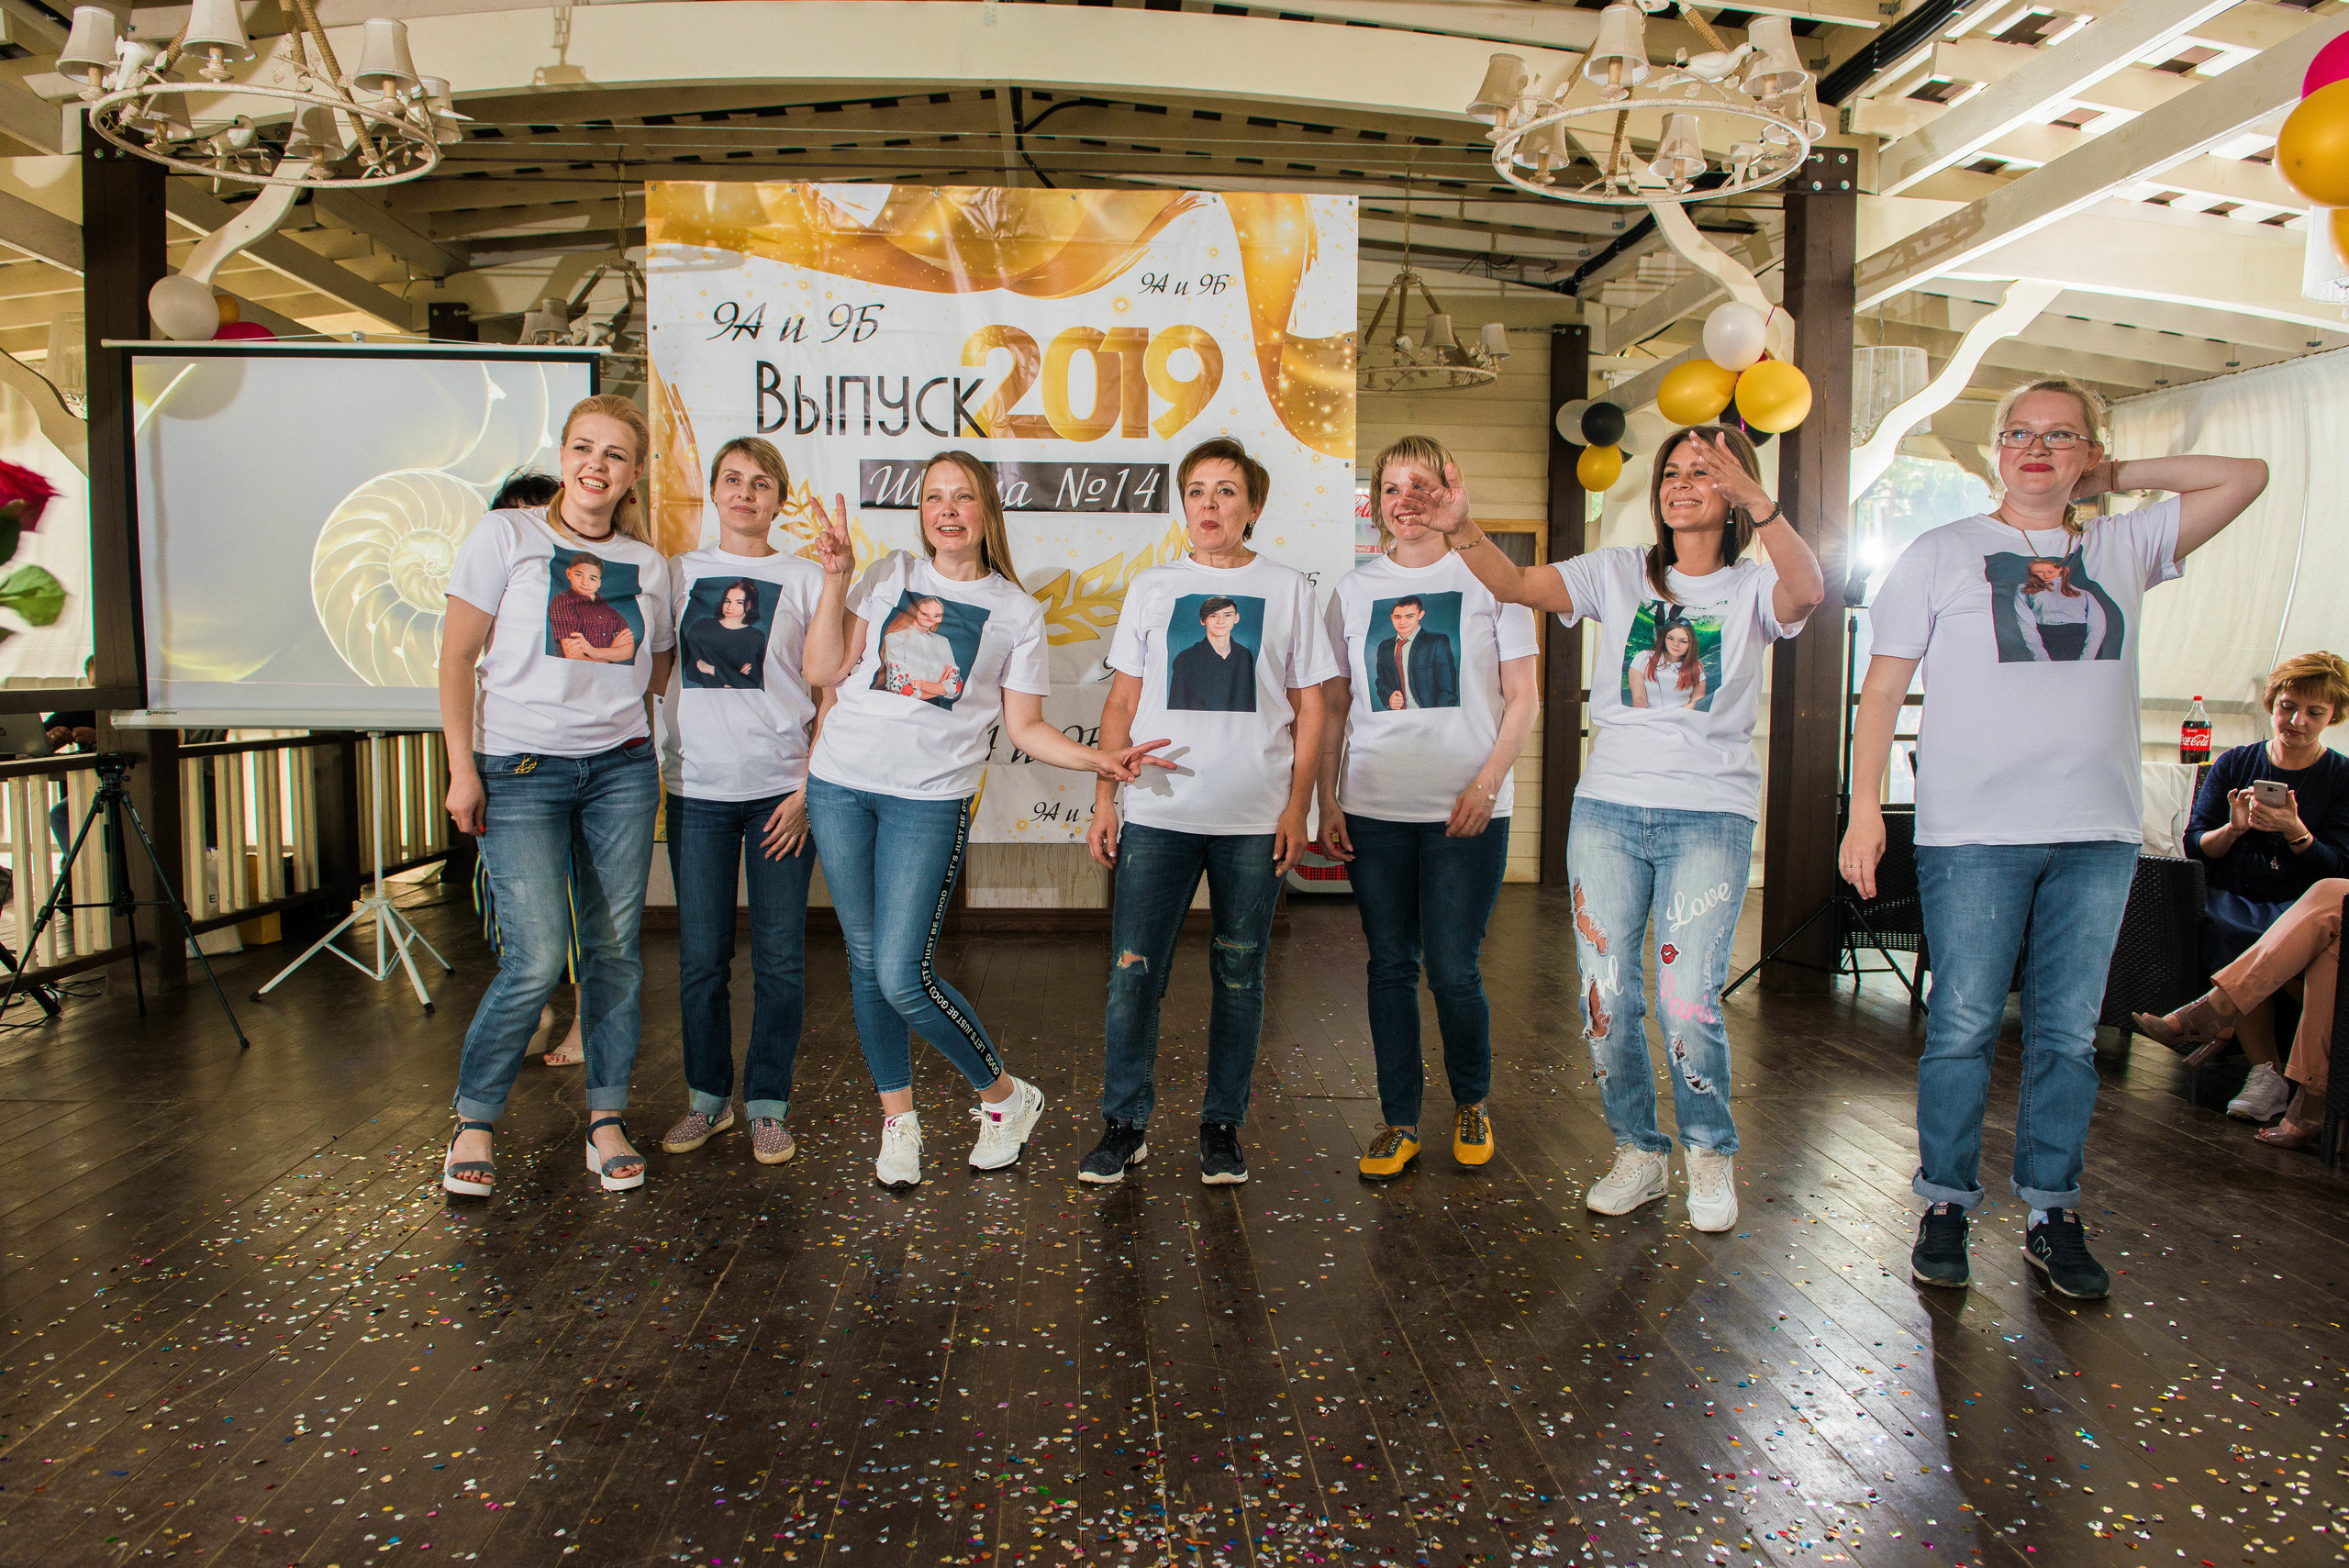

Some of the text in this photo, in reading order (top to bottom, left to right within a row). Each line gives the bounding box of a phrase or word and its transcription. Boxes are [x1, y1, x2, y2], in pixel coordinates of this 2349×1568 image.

[1138, 272, 1230, 295] 9А и 9Б
[706, 301, 885, 343] 9А и 9Б
[961, 324, 1224, 441] 2019
[959, 813, 967, 828] BE
[1030, 801, 1061, 822] 9А
[1065, 808, 1080, 822] и
[956, 828, 965, 854] JUST
[945, 854, 959, 883] LET'S
[1666, 882, 1732, 932] Love
[921, 889, 948, 986] LET'S JUST BE GOOD
[1659, 968, 1716, 1024] Paris
[929, 985, 986, 1054] LET'S JUST BE GOOD
[985, 1052, 1000, 1076] GOOD
